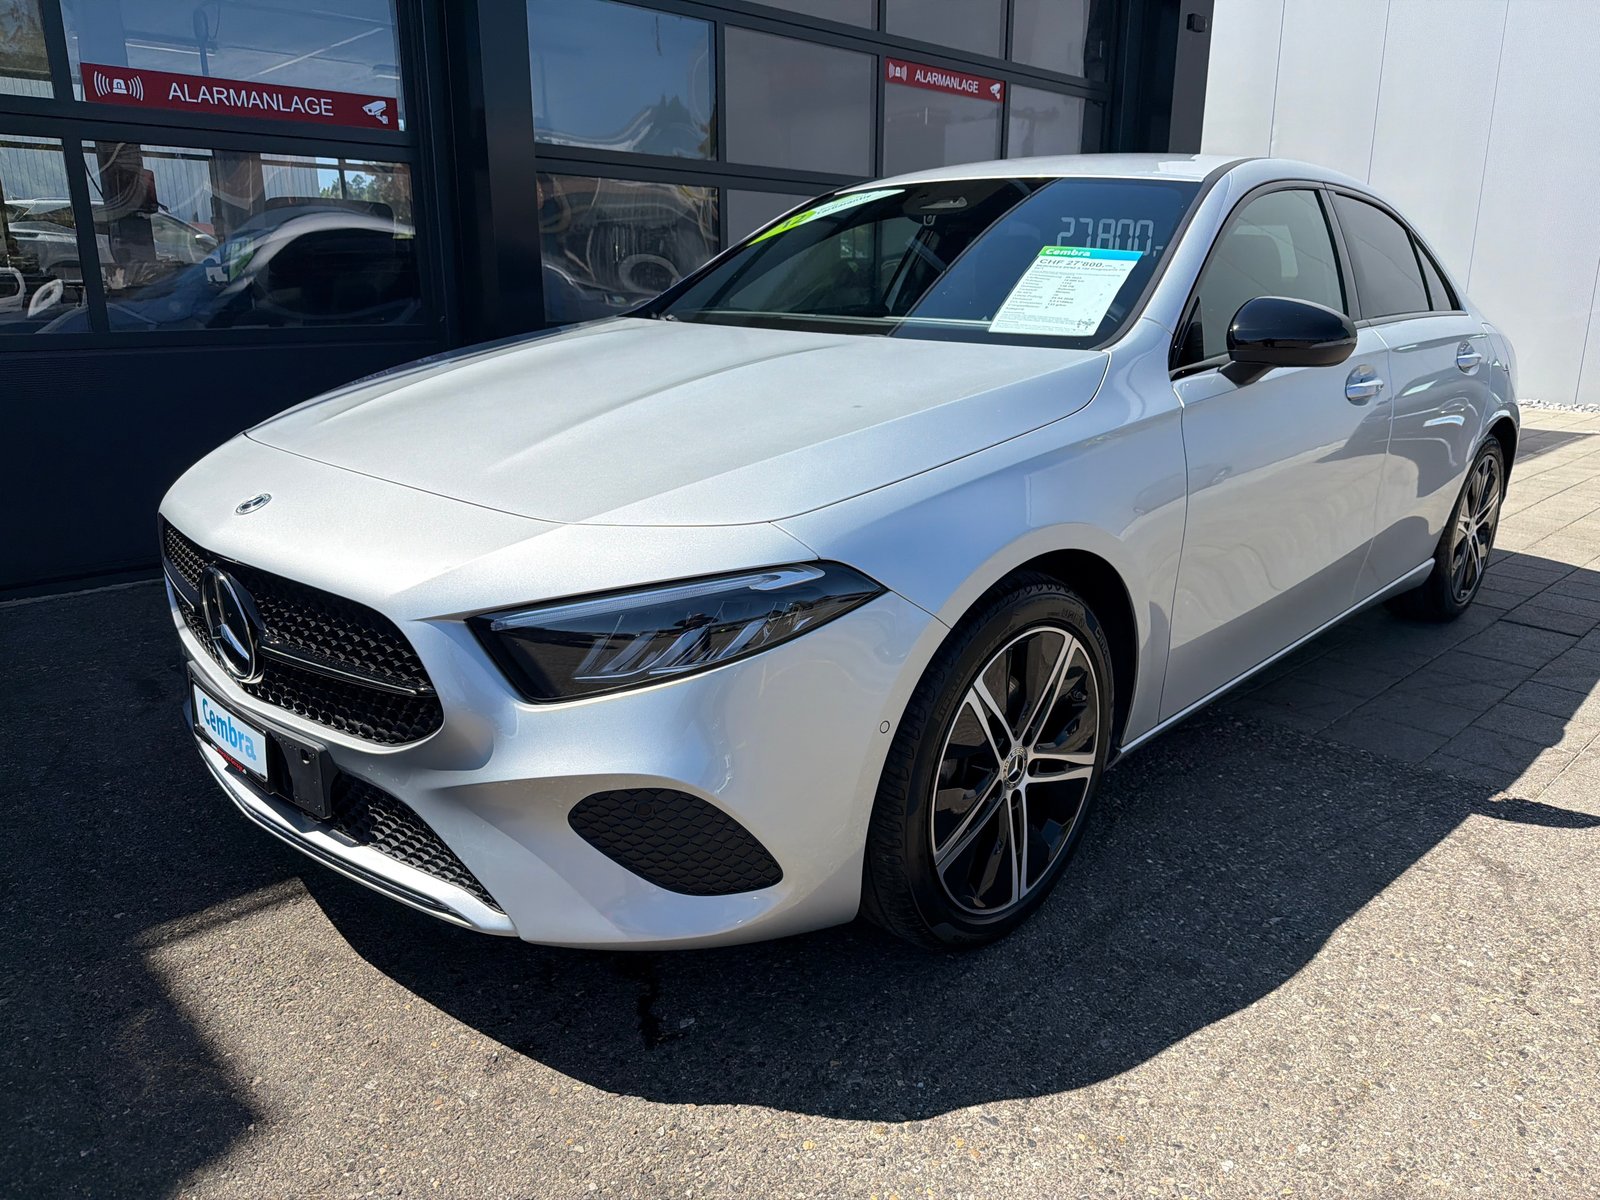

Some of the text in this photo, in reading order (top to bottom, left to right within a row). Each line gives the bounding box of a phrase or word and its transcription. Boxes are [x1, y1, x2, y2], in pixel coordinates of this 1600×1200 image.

[915, 69, 979, 93] ALARMANLAGE
[168, 82, 334, 117] ALARMANLAGE
[1039, 258, 1063, 266] CHF
[1045, 248, 1091, 257] Cembra
[202, 697, 257, 761] Cembra
